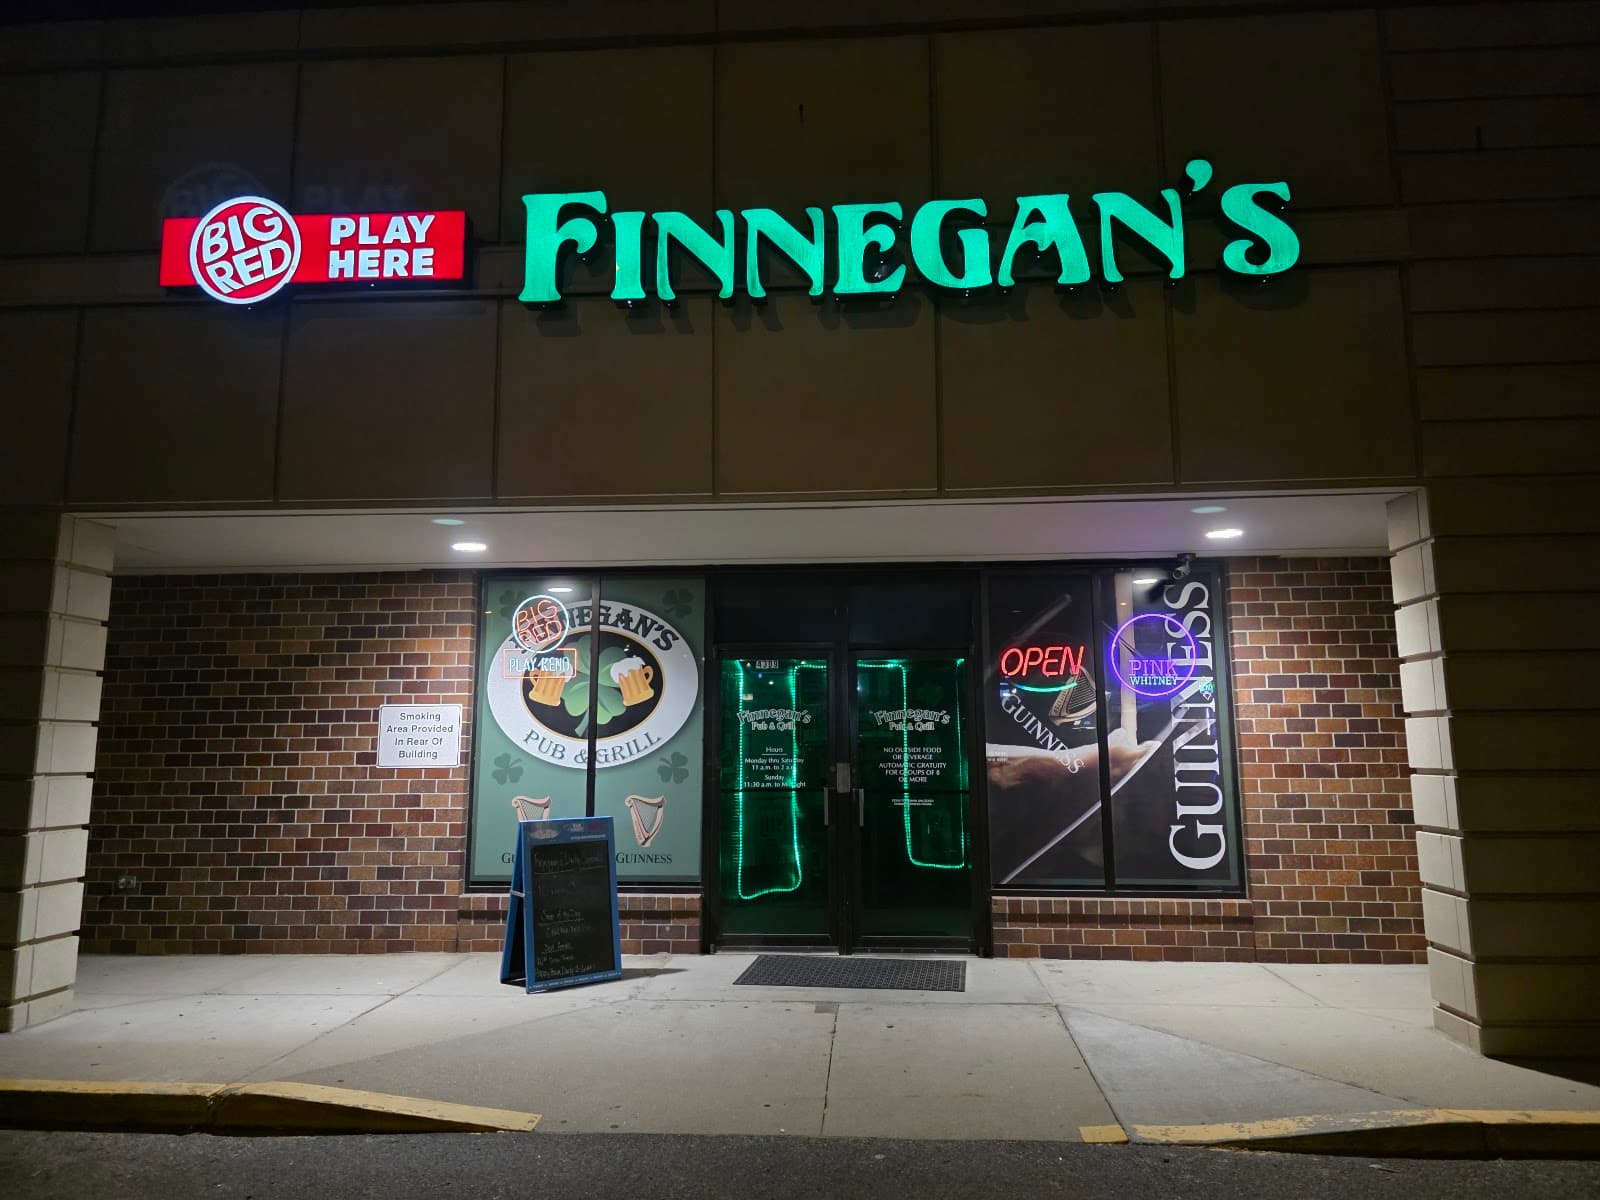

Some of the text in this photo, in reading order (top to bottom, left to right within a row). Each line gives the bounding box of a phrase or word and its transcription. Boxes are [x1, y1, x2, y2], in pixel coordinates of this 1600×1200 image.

[202, 206, 283, 263] BIG
[330, 214, 435, 246] PLAY
[517, 158, 1302, 303] FINNEGAN'S
[206, 239, 292, 294] RED
[328, 248, 434, 279] HERE
[516, 599, 558, 632] BIG
[518, 620, 562, 647] RED
[509, 656, 571, 672] PLAY KENO
[1000, 645, 1085, 677] OPEN
[1128, 659, 1178, 676] PINK
[1129, 676, 1178, 686] WHITNEY
[400, 712, 441, 722] Smoking
[736, 709, 812, 725] Finnegan's
[751, 721, 768, 731] Pub
[874, 708, 951, 726] Finnegan's
[1164, 581, 1226, 870] GUINNESS
[387, 724, 454, 733] Area Provided
[394, 737, 443, 746] In Rear Of
[523, 729, 662, 765] PUB & GRILL
[398, 749, 438, 760] Building
[616, 852, 673, 864] GUINNESS
